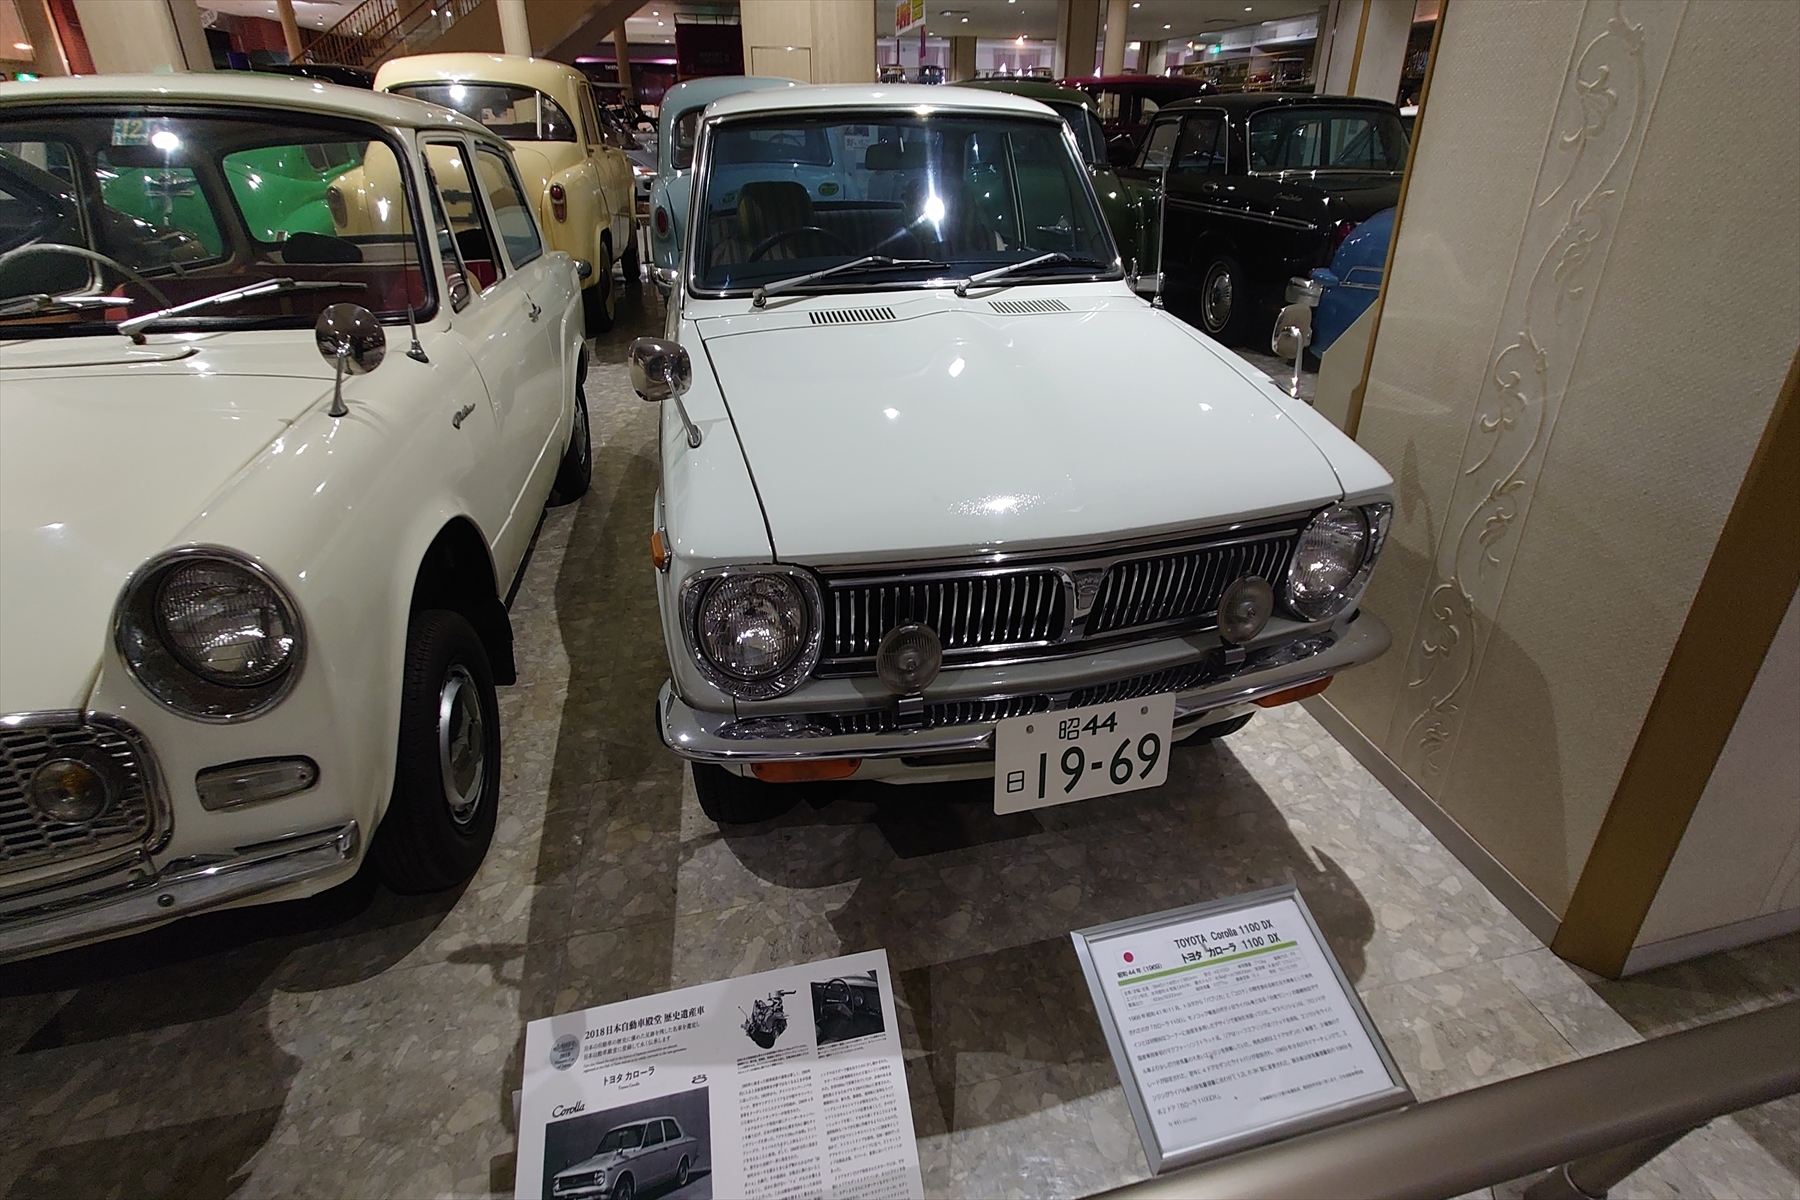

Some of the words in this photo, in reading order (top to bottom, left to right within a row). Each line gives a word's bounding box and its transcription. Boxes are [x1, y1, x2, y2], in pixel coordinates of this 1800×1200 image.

[1058, 711, 1118, 740] 昭44
[1007, 770, 1025, 793] 日
[1038, 732, 1161, 799] 19-69
[1174, 934, 1207, 949] TOYOTA
[1210, 928, 1238, 941] Corolla
[1239, 922, 1260, 935] 1100
[1261, 919, 1274, 930] DX
[1181, 950, 1202, 964] トヨタ
[1207, 942, 1237, 957] カローラ
[1242, 936, 1265, 950] 1100
[1268, 932, 1281, 944] DX
[603, 1074, 622, 1086] トヨタ
[625, 1066, 655, 1081] カローラ
[552, 1100, 586, 1118] Corolla
